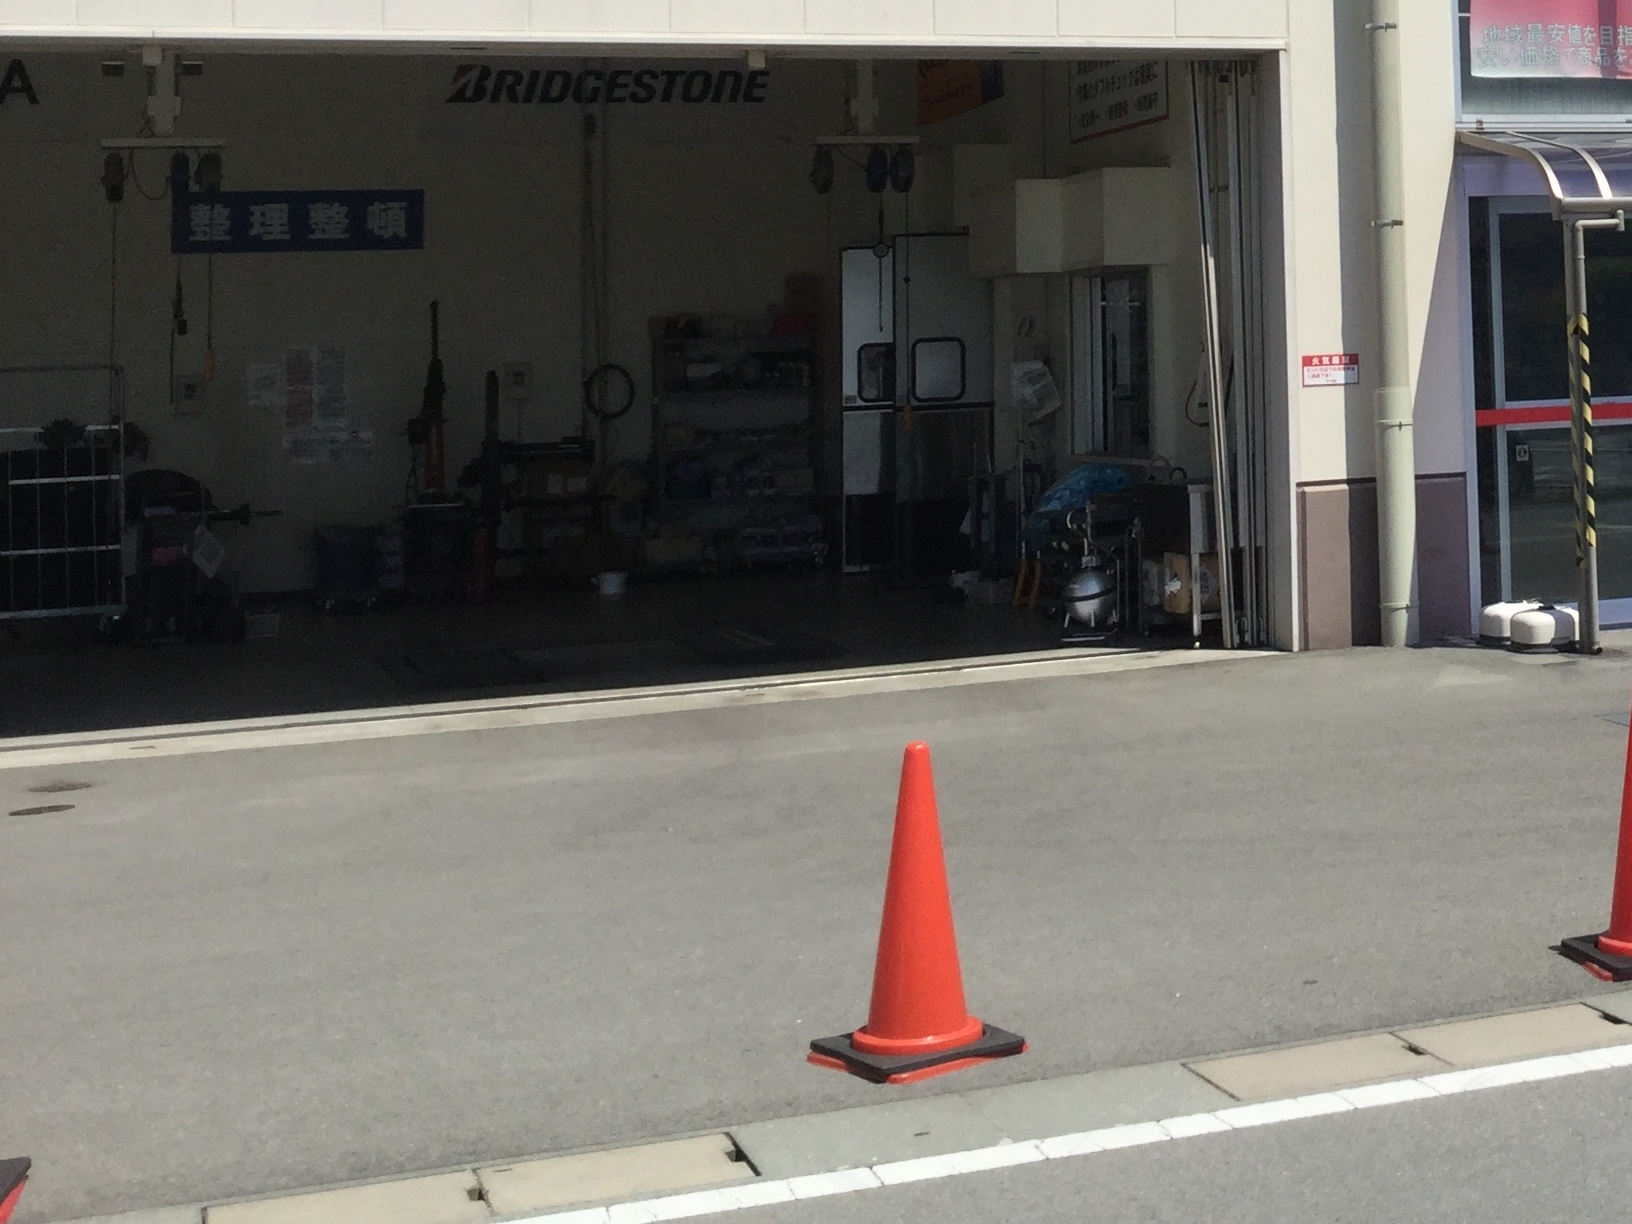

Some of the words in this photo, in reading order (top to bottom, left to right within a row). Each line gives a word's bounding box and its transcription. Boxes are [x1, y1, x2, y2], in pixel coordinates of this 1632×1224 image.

[446, 64, 771, 104] BRIDGESTONE
[187, 201, 408, 242] 整理整頓
